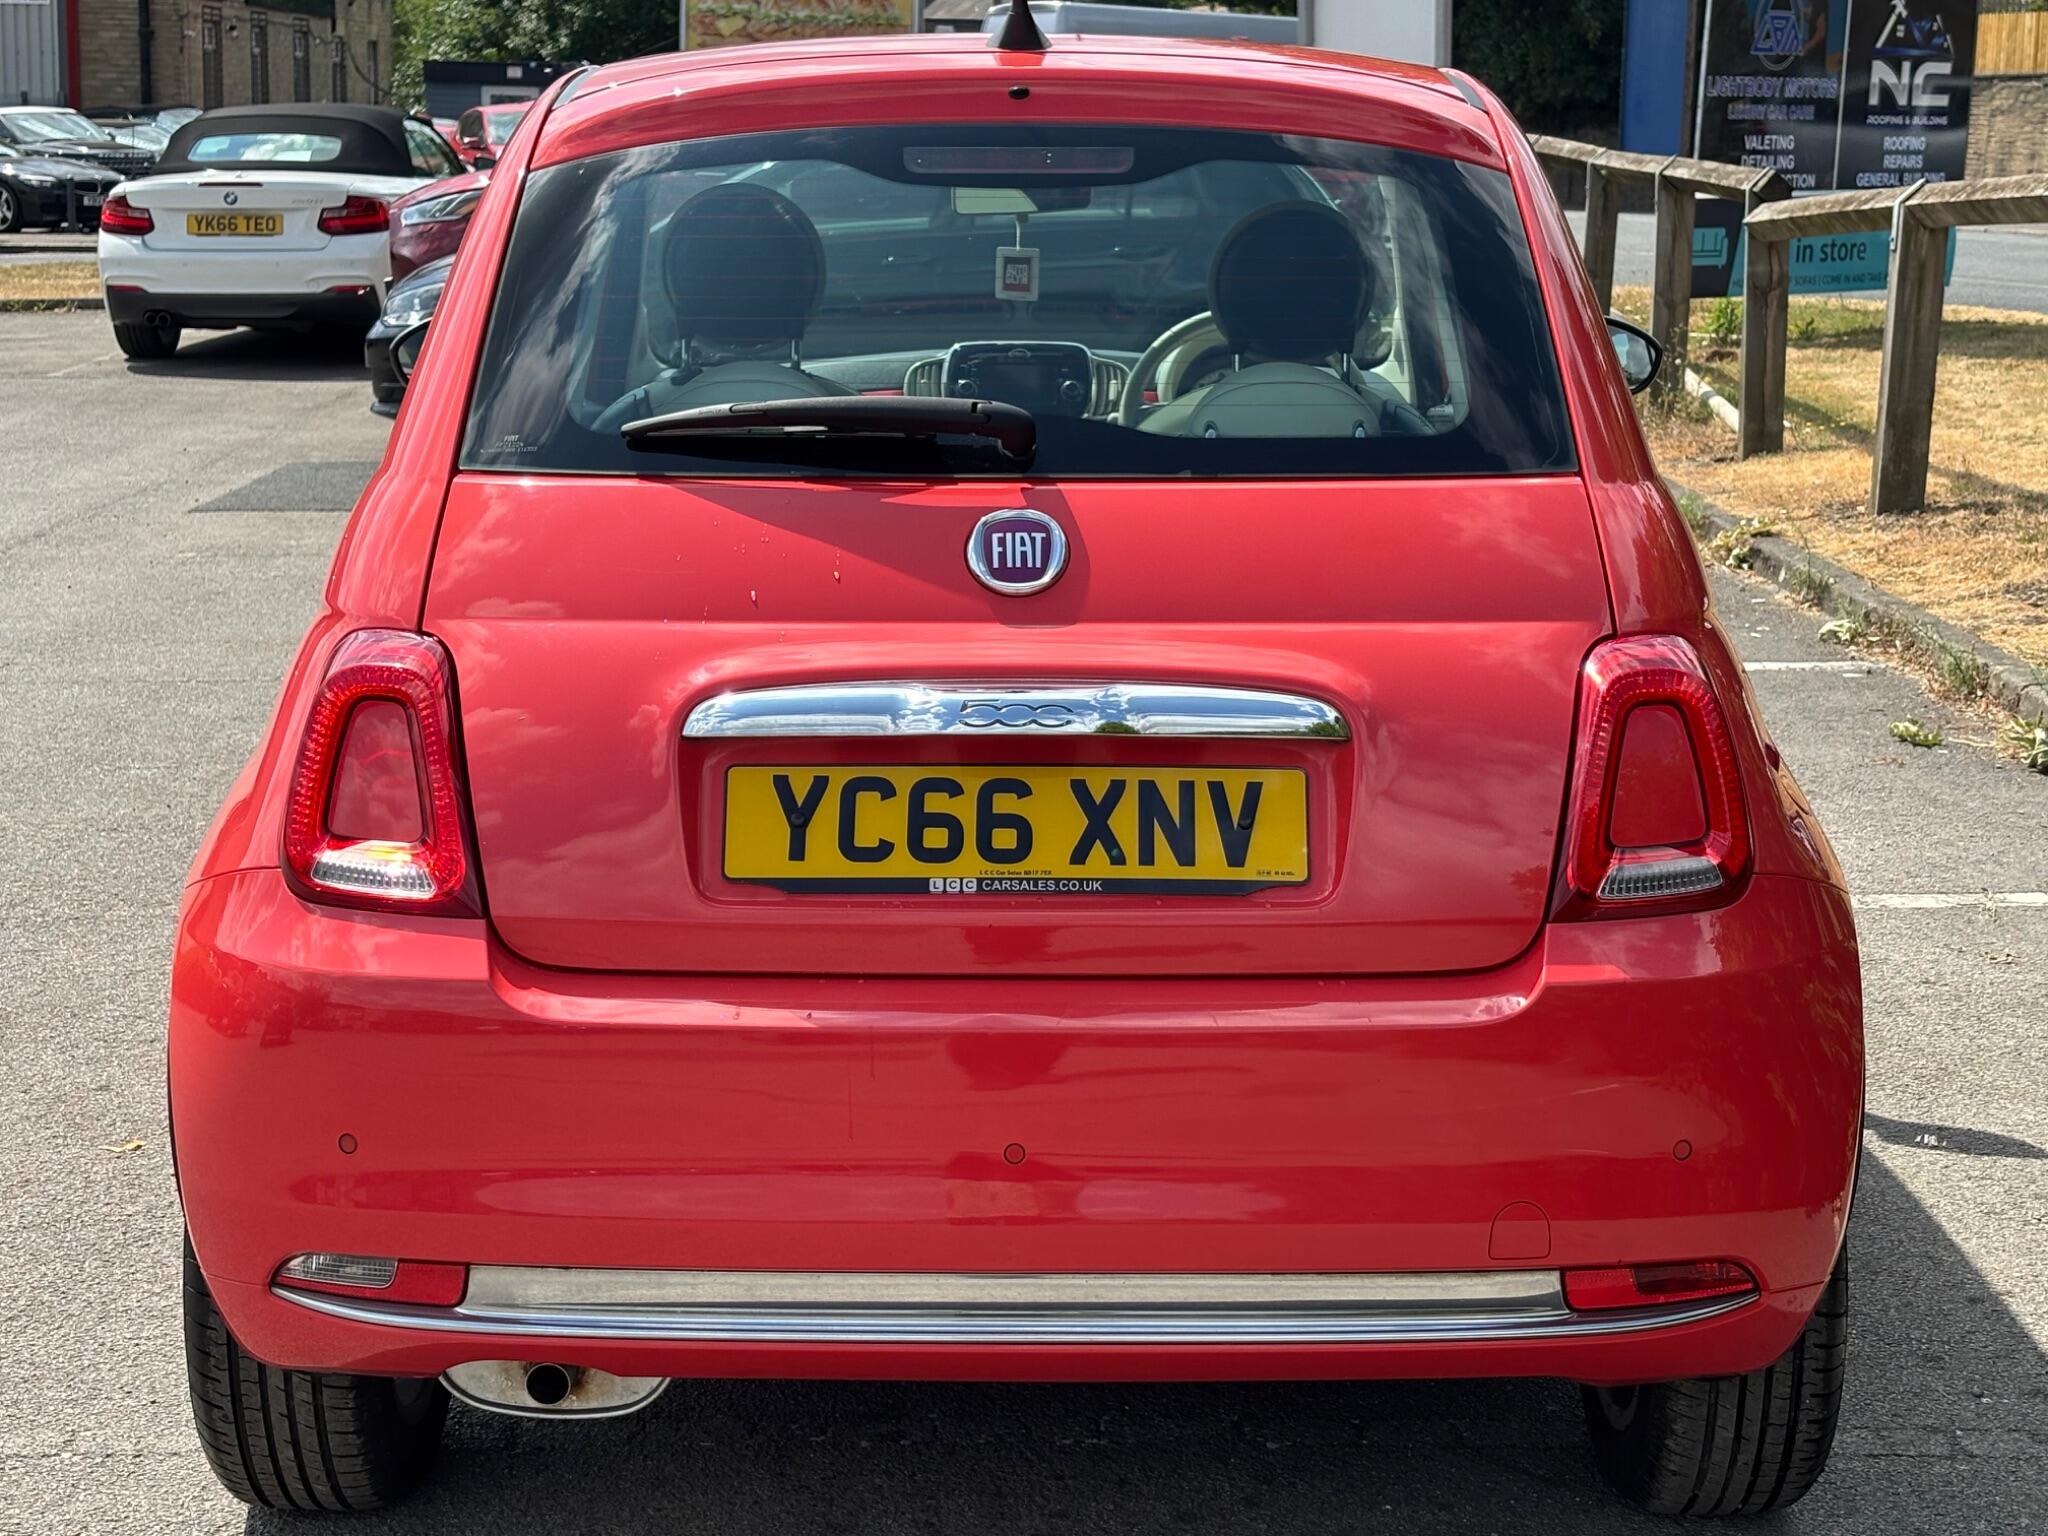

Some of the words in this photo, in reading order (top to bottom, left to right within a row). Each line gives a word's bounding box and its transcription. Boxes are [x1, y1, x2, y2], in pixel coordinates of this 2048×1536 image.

[1868, 60, 1952, 107] NC
[1744, 135, 1795, 150] VALETING
[1883, 136, 1927, 151] ROOFING
[1741, 155, 1795, 169] DETAILING
[1883, 154, 1923, 168] REPAIRS
[1856, 172, 1900, 187] GENERAL
[194, 216, 238, 232] YK66
[1795, 238, 1813, 263] in
[1819, 240, 1867, 262] store
[992, 532, 1046, 569] FIAT
[959, 699, 1074, 728] 500
[772, 774, 1034, 864] YC66
[1068, 778, 1264, 867] XNV
[982, 880, 1103, 891] CARSALES.CO.UK
